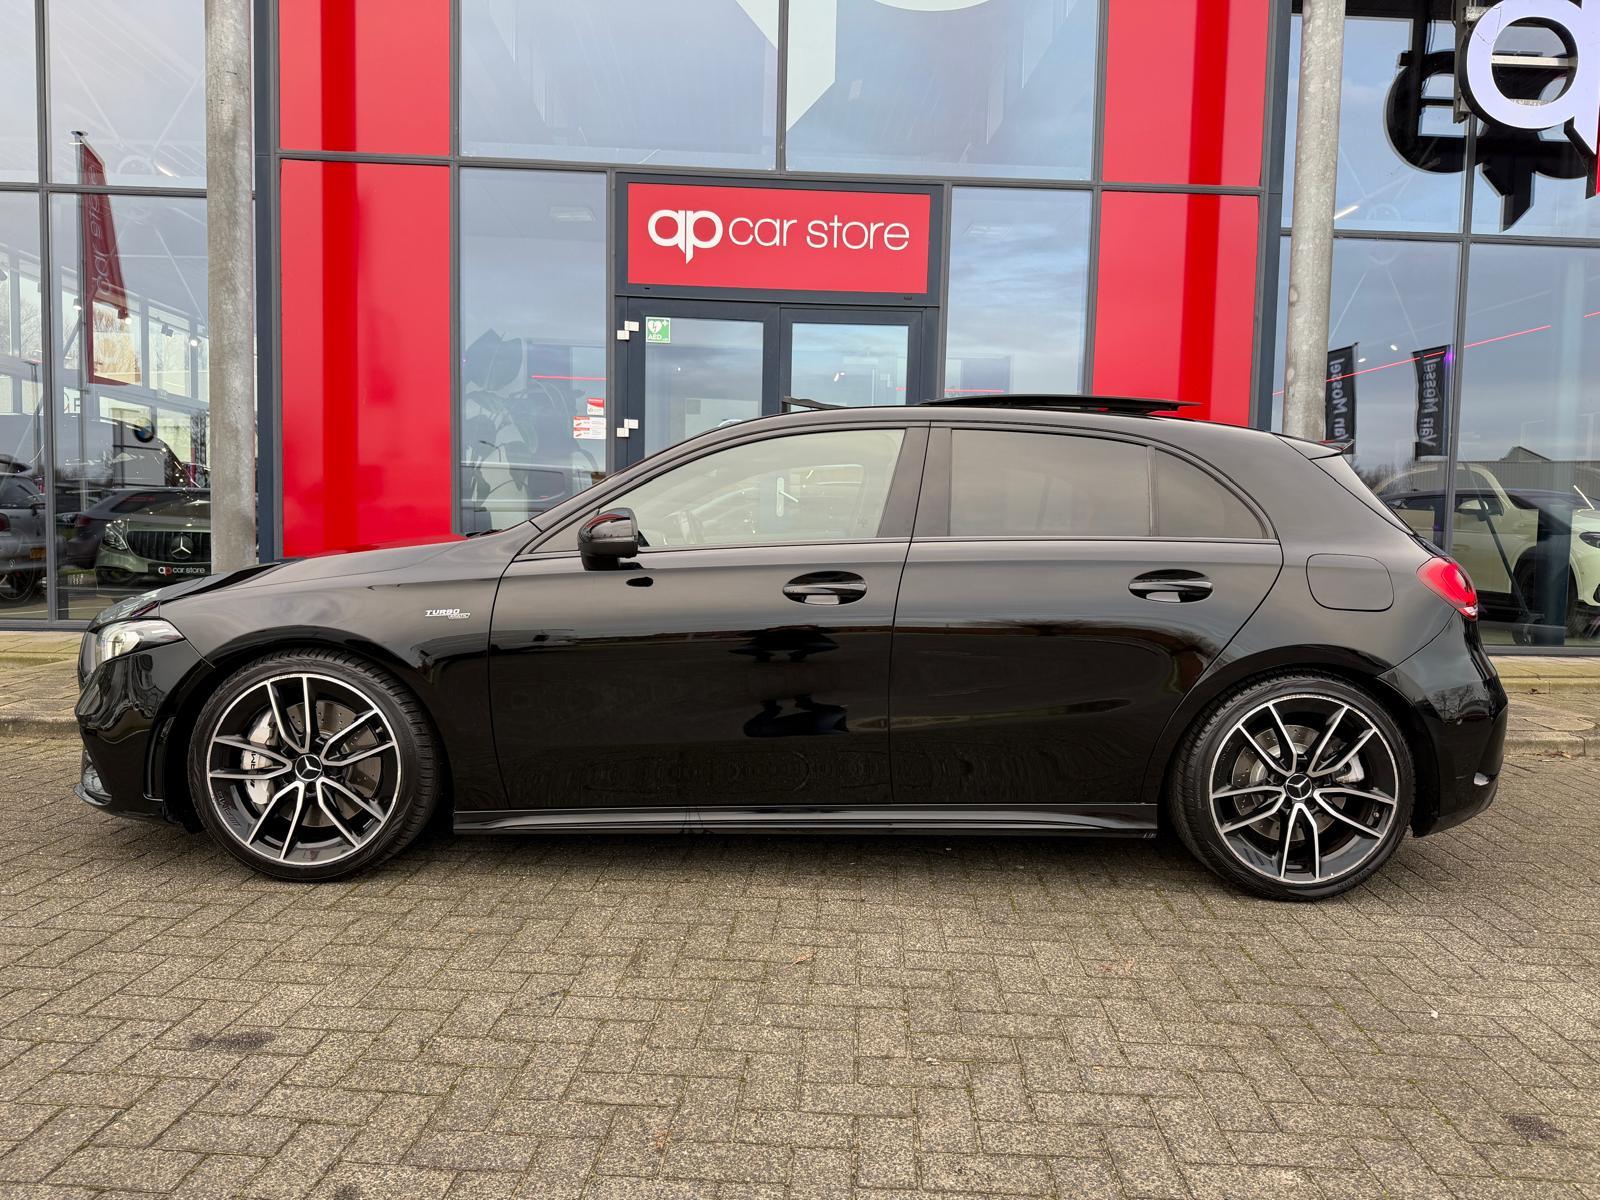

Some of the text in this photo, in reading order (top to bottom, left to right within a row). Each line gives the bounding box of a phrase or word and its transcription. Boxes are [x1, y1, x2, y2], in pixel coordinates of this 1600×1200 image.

[647, 209, 910, 265] ap car store
[648, 333, 662, 341] AED
[424, 608, 460, 616] TURBO
